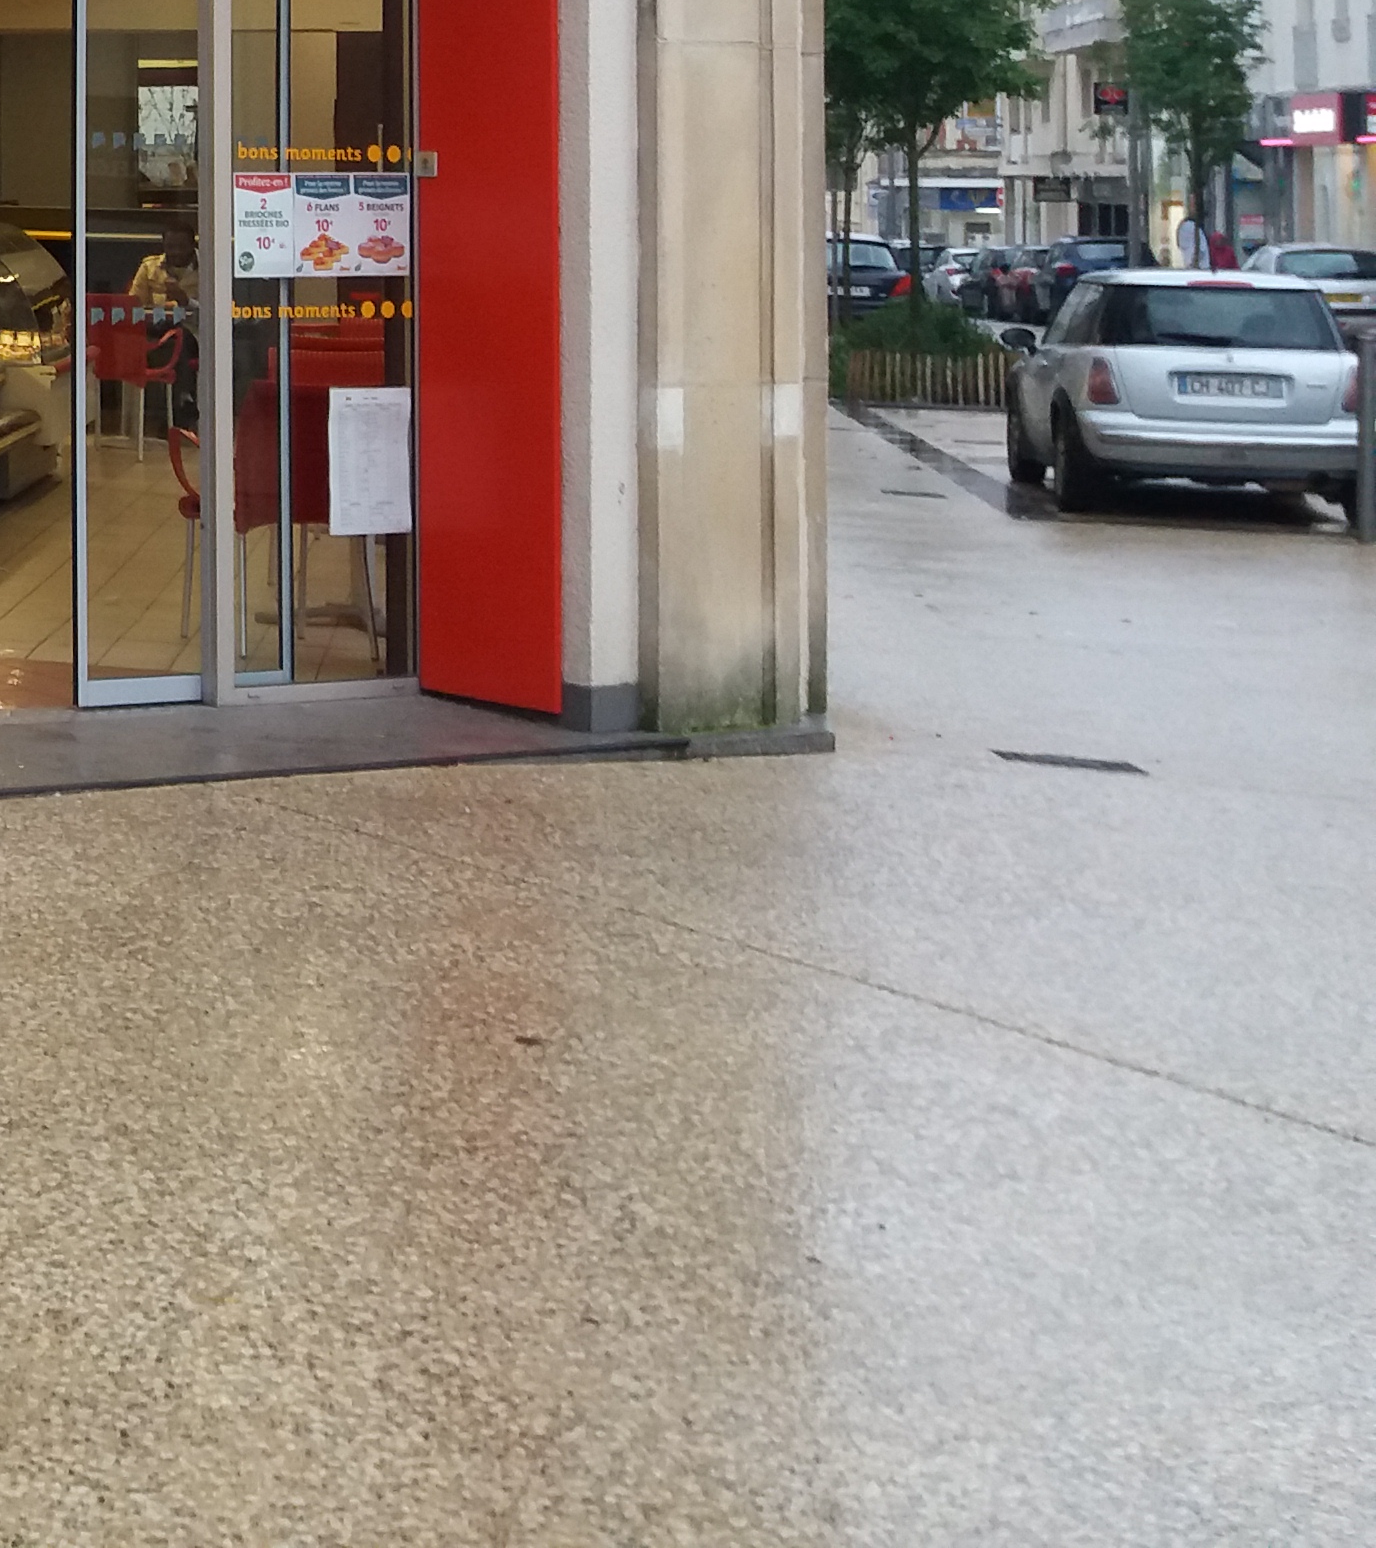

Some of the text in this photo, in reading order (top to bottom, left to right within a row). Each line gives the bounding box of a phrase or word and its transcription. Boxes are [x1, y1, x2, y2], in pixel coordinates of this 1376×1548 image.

[237, 140, 363, 162] bons moments
[260, 199, 268, 210] 2
[315, 204, 340, 212] FLANS
[366, 203, 404, 212] BEIGNETS
[244, 211, 284, 219] BRIOCHES
[232, 299, 356, 319] bons moments
